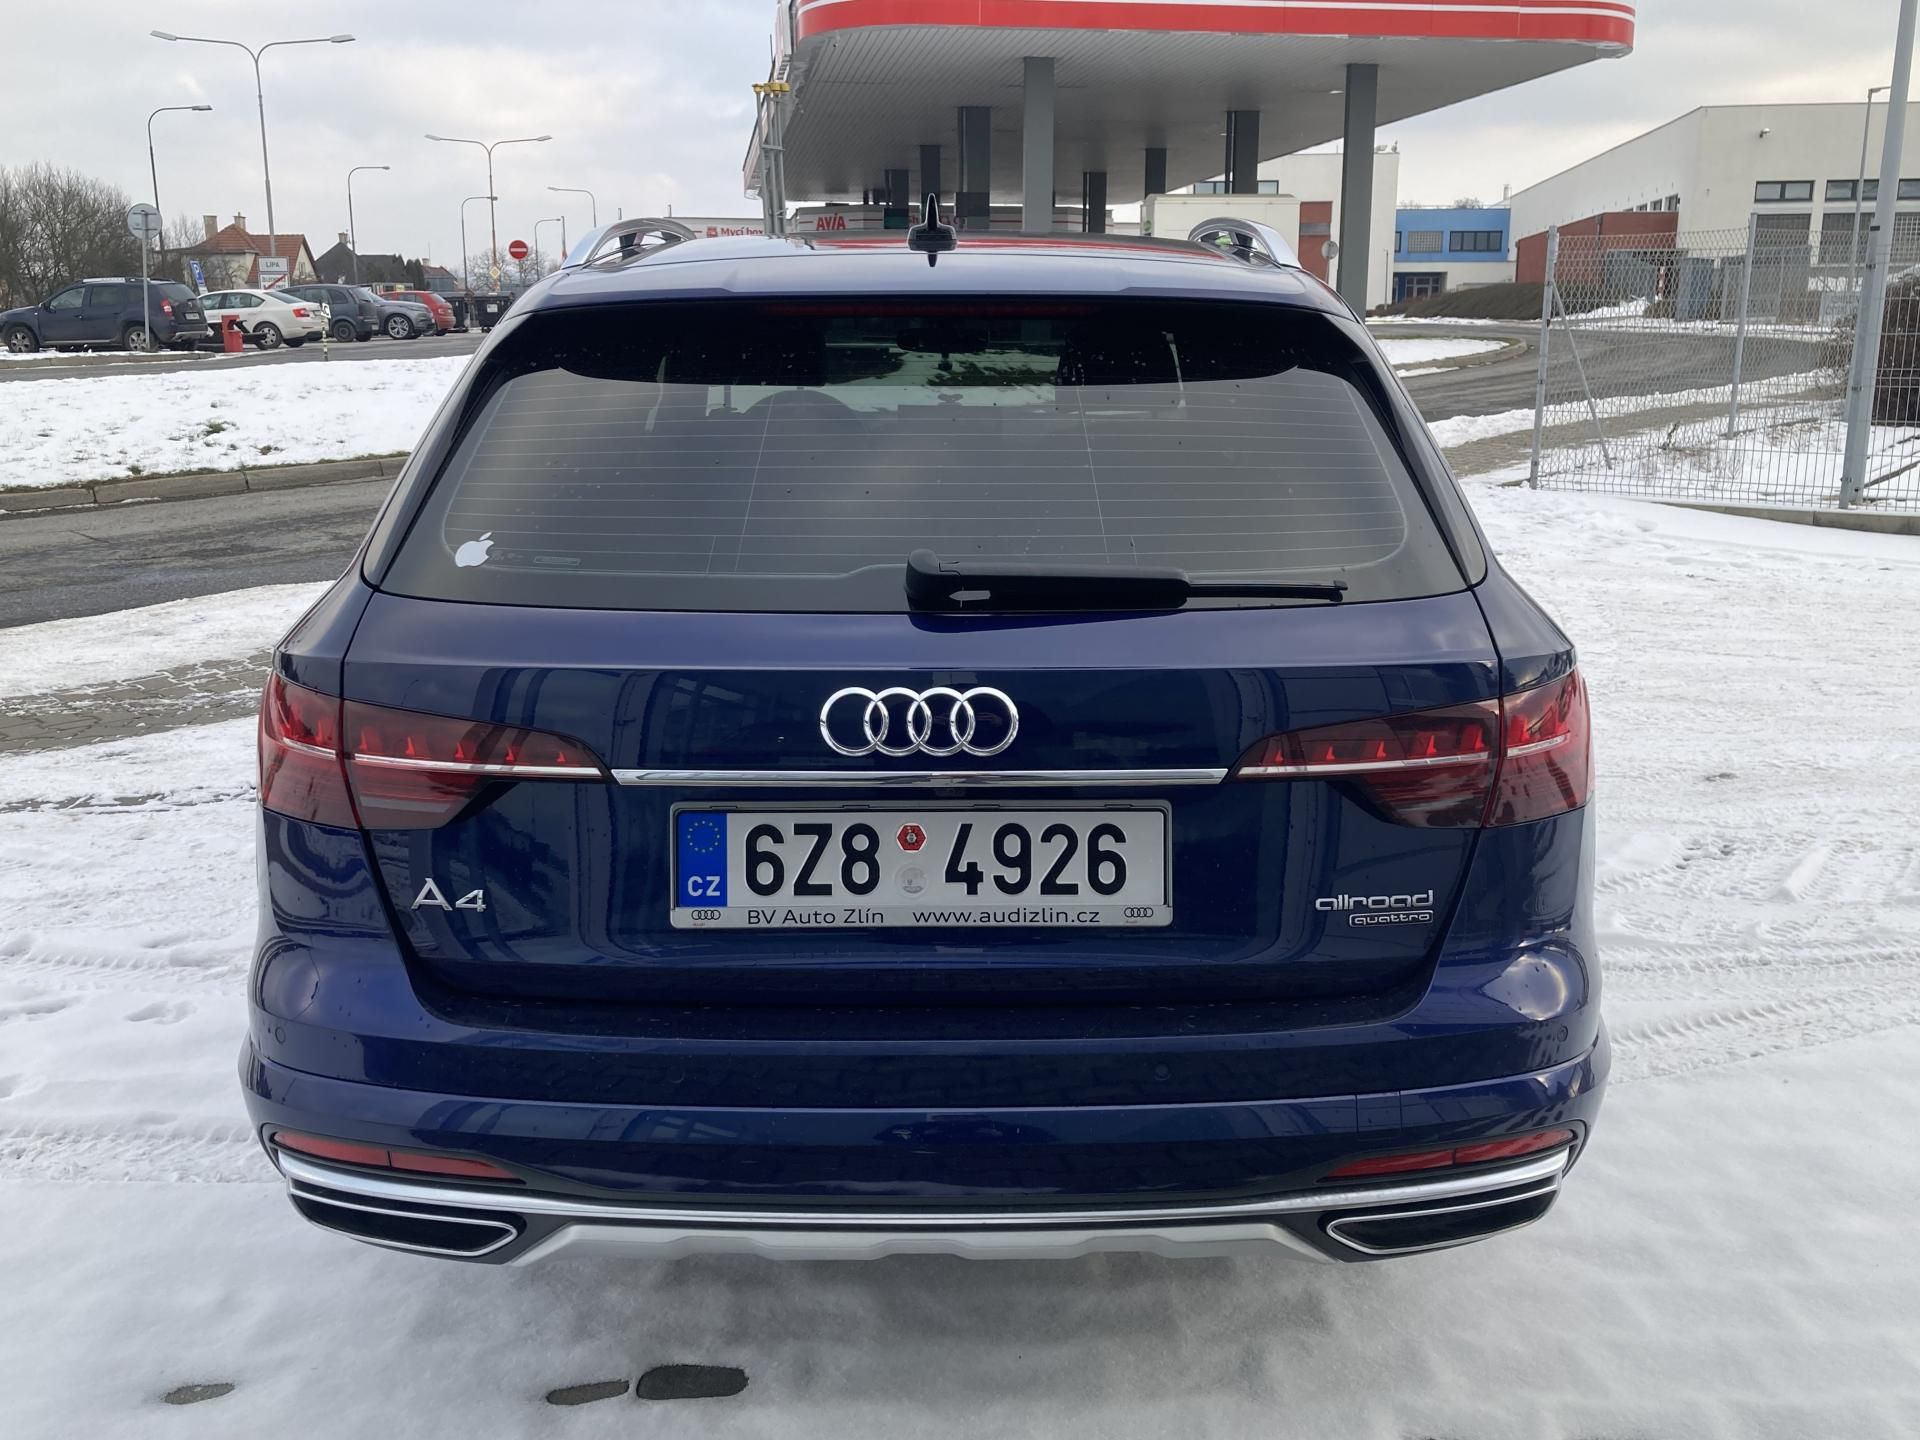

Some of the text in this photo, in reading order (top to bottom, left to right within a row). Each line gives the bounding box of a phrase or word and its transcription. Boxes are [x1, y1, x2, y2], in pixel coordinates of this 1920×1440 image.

[745, 823, 1126, 896] 6Z8 4926
[411, 877, 487, 912] A4
[688, 876, 721, 896] CZ
[1315, 889, 1434, 910] allroad
[747, 908, 884, 924] BV Auto Zlín
[912, 907, 1100, 923] www.audizlin.cz
[1354, 913, 1430, 925] quattro
